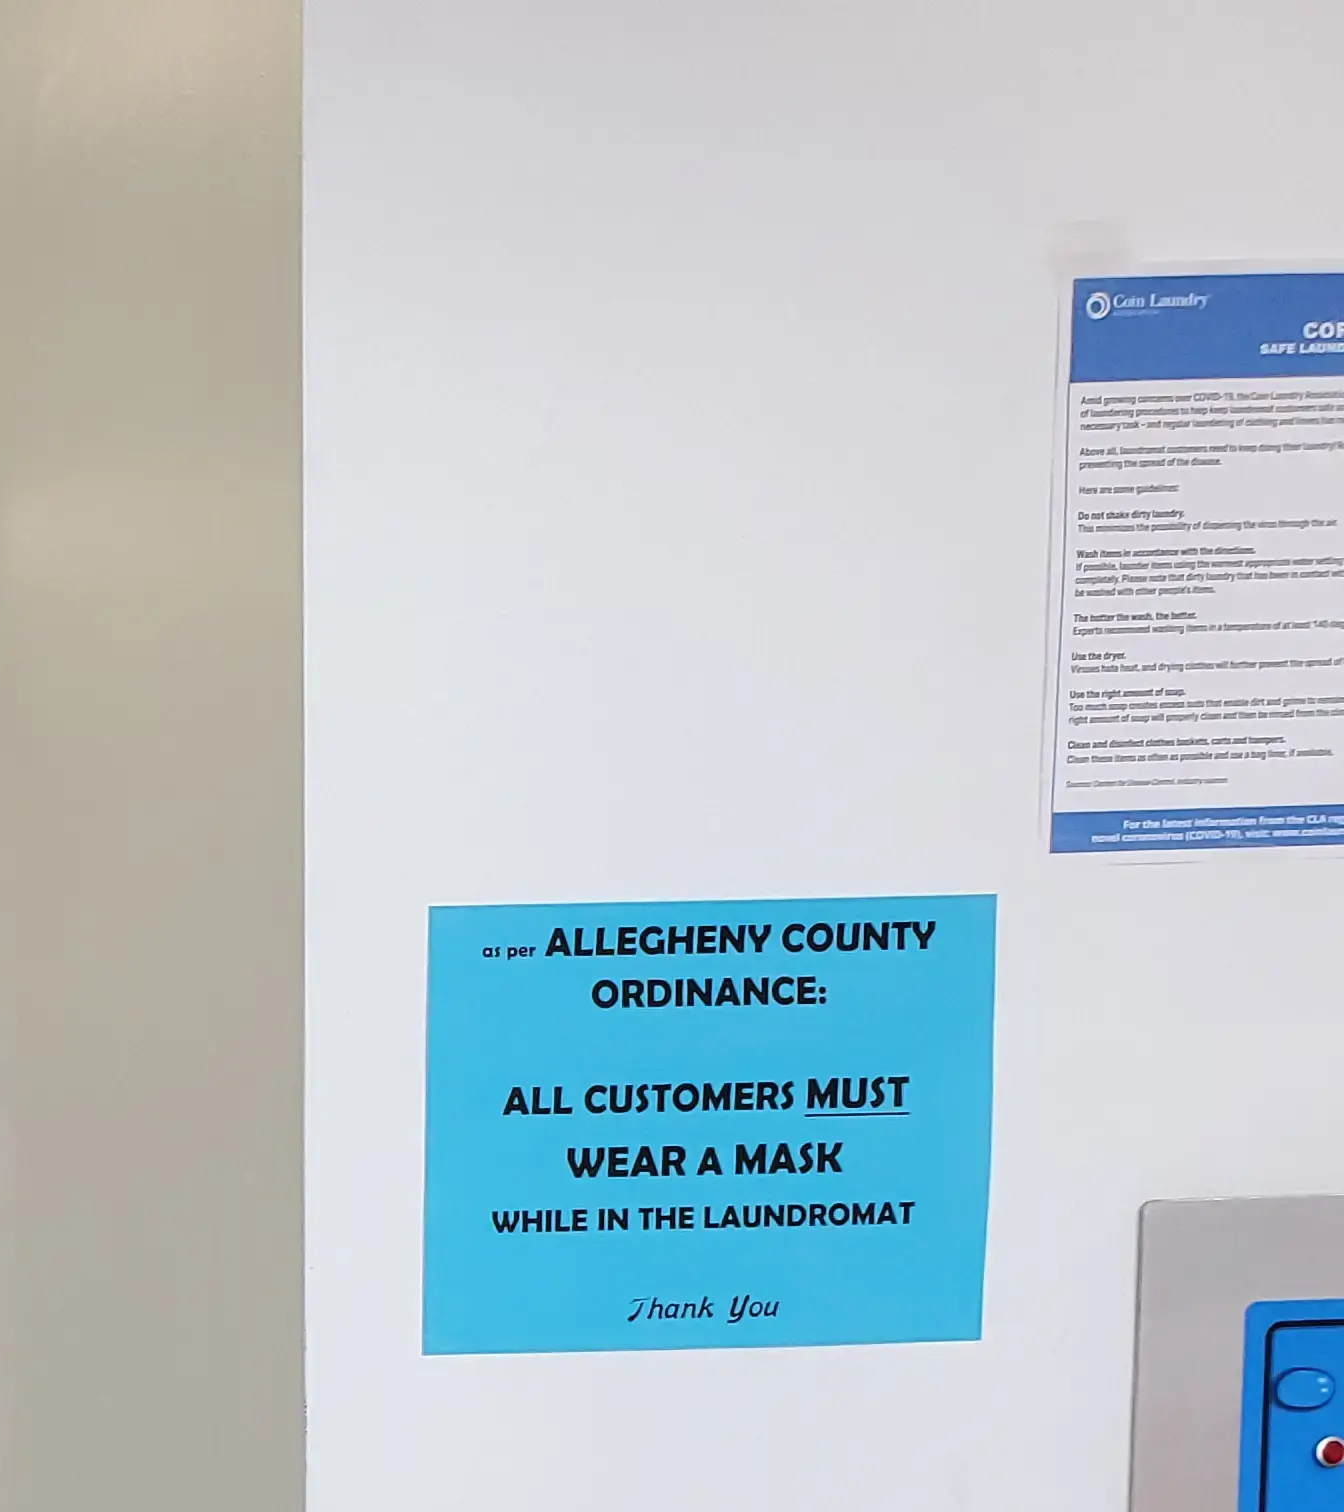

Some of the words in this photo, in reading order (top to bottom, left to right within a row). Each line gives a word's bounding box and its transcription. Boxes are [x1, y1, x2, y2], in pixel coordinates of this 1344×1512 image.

[1113, 294, 1145, 308] Coin
[1260, 343, 1296, 355] SAFE
[1078, 511, 1089, 520] Do
[1091, 511, 1104, 520] not
[1131, 510, 1151, 520] dirty
[1072, 652, 1087, 661] Use
[1088, 651, 1102, 660] the
[1069, 690, 1085, 699] Use
[1086, 690, 1100, 698] the
[1123, 820, 1141, 829] For
[1142, 819, 1161, 828] the
[482, 945, 501, 959] as
[506, 943, 537, 962] per
[545, 924, 772, 958] ALLEGHENY
[780, 920, 936, 953] COUNTY
[590, 975, 828, 1009] ORDINANCE:
[502, 1085, 573, 1116] ALL
[584, 1080, 795, 1114] CUSTOMERS
[805, 1076, 910, 1111] MUST
[567, 1144, 687, 1178] WEAR
[696, 1146, 724, 1176] A
[734, 1142, 844, 1176] MASK
[492, 1207, 587, 1234] WHILE
[598, 1207, 629, 1231] IN
[638, 1205, 695, 1231] THE
[703, 1201, 916, 1229] LAUNDROMAT
[626, 1295, 714, 1322] Thank
[726, 1293, 779, 1324] You
